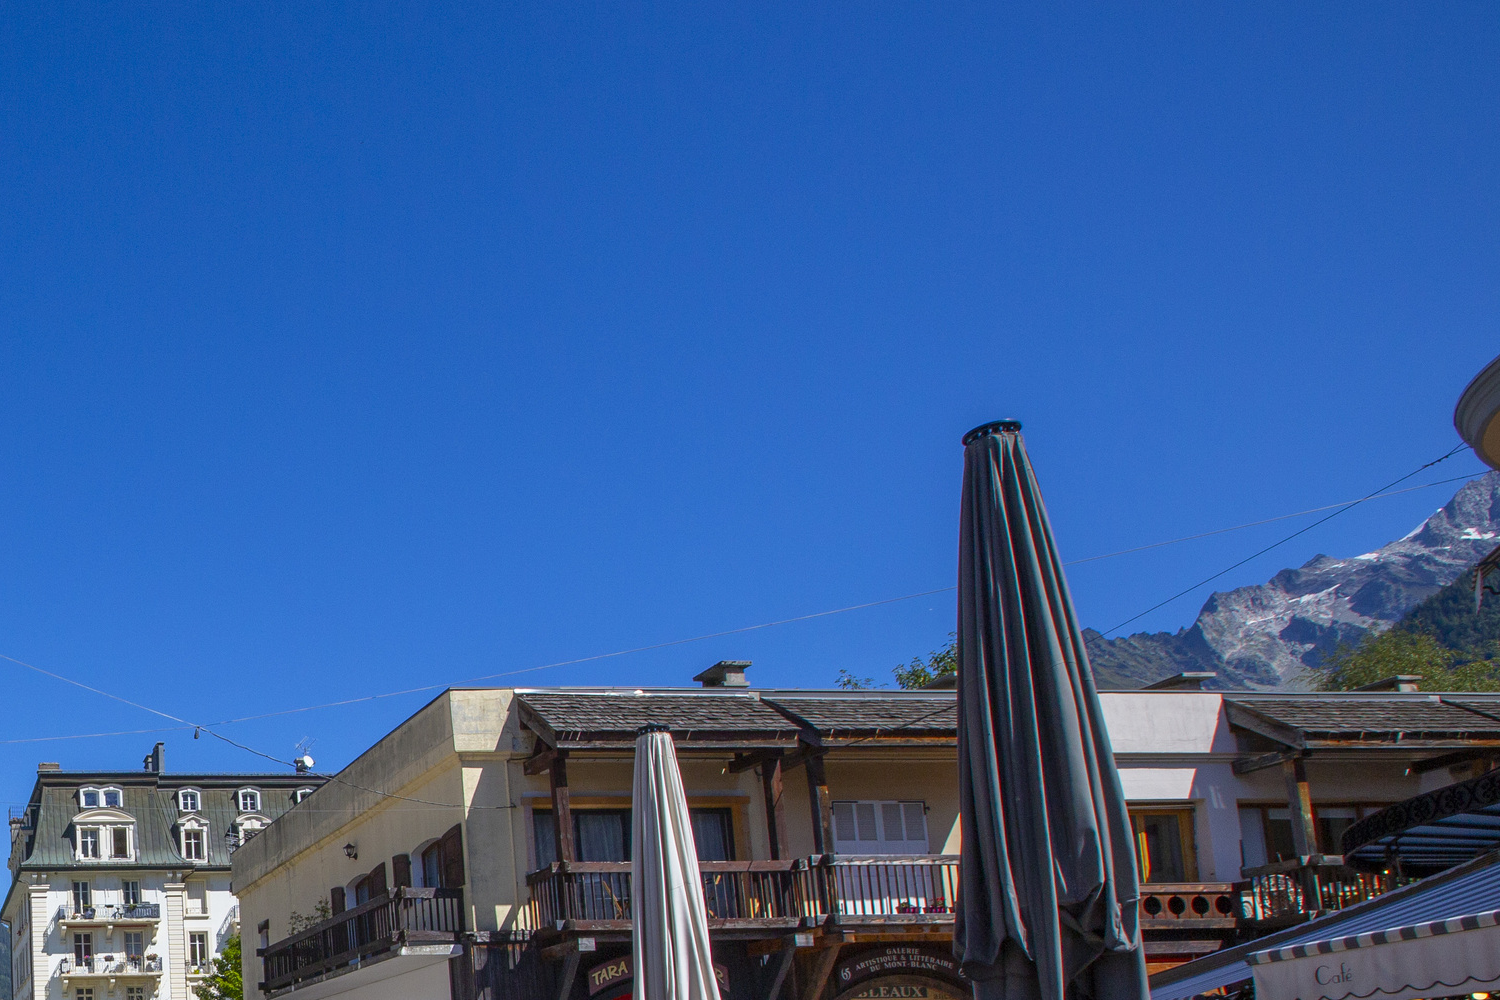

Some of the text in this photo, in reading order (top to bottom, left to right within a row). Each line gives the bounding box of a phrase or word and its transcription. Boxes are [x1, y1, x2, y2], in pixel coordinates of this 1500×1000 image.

[886, 947, 920, 955] GALERIE
[855, 954, 900, 972] ARTISTIQUE
[869, 961, 938, 973] DU MONT-BLANC
[591, 960, 629, 986] TARA
[1314, 962, 1353, 986] Café
